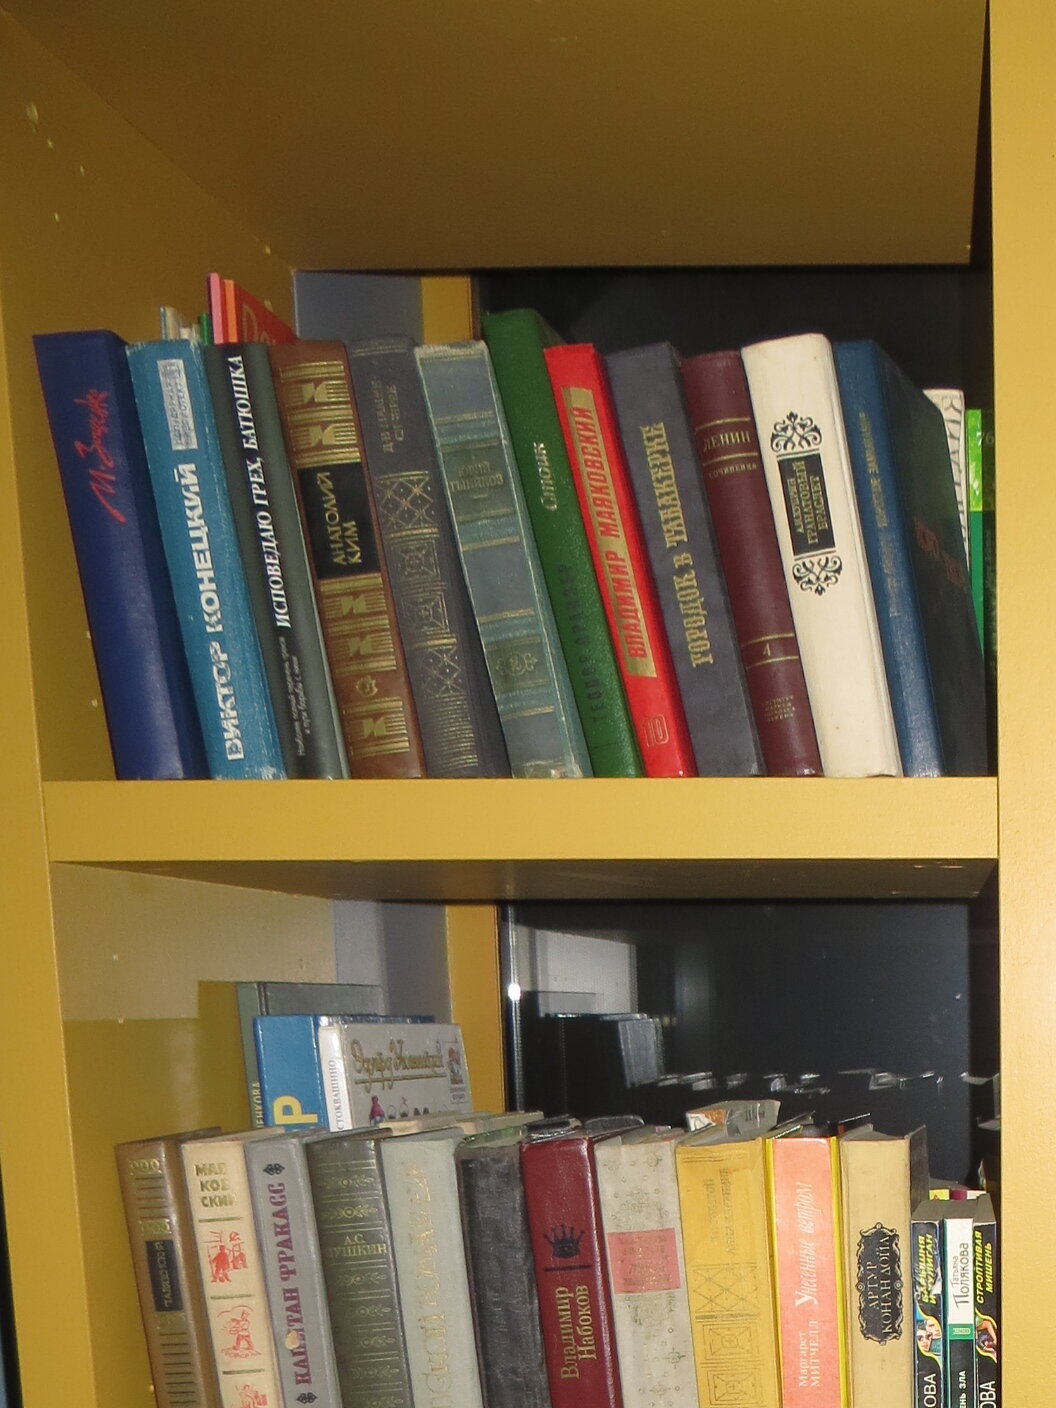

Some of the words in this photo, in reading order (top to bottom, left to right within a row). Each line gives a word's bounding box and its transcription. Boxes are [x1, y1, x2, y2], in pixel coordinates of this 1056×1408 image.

[227, 355, 258, 450] БАТЮШКА
[569, 405, 621, 540] МАЯКОВСКИЙ
[702, 430, 751, 453] ЛЕНИН
[317, 471, 346, 566] АНАТОЛИЙ
[640, 421, 690, 548] ТАБАКЕРКЕ
[792, 461, 819, 545] ГРАНАТОВЫЙ
[809, 475, 829, 531] БРАСЛЕТ
[173, 463, 224, 632] КОНЕЦКИЙ
[255, 509, 291, 628] ИСПОВЕДАЮ
[341, 521, 362, 564] КИМ
[603, 550, 648, 660] ВЛАДИМИР
[673, 572, 714, 669] ГОРОДОК
[762, 642, 772, 657] 4
[213, 640, 245, 761] ВИКТОР
[268, 1181, 299, 1281] ФРАКАСС
[876, 1236, 893, 1275] ДОЙЛ
[974, 1230, 985, 1304] СТРОПТИВАЯ
[984, 1241, 994, 1294] МИШЕНЬ
[866, 1261, 880, 1309] АРТУР
[878, 1279, 894, 1334] КОНАН
[949, 1255, 960, 1289] Татьяна
[552, 1285, 581, 1381] Владимир
[574, 1284, 600, 1361] Набоков
[798, 1330, 811, 1388] Маргарет
[808, 1320, 821, 1388] МИТЧЕЛЛ
[958, 1370, 968, 1389] ЗЛА
